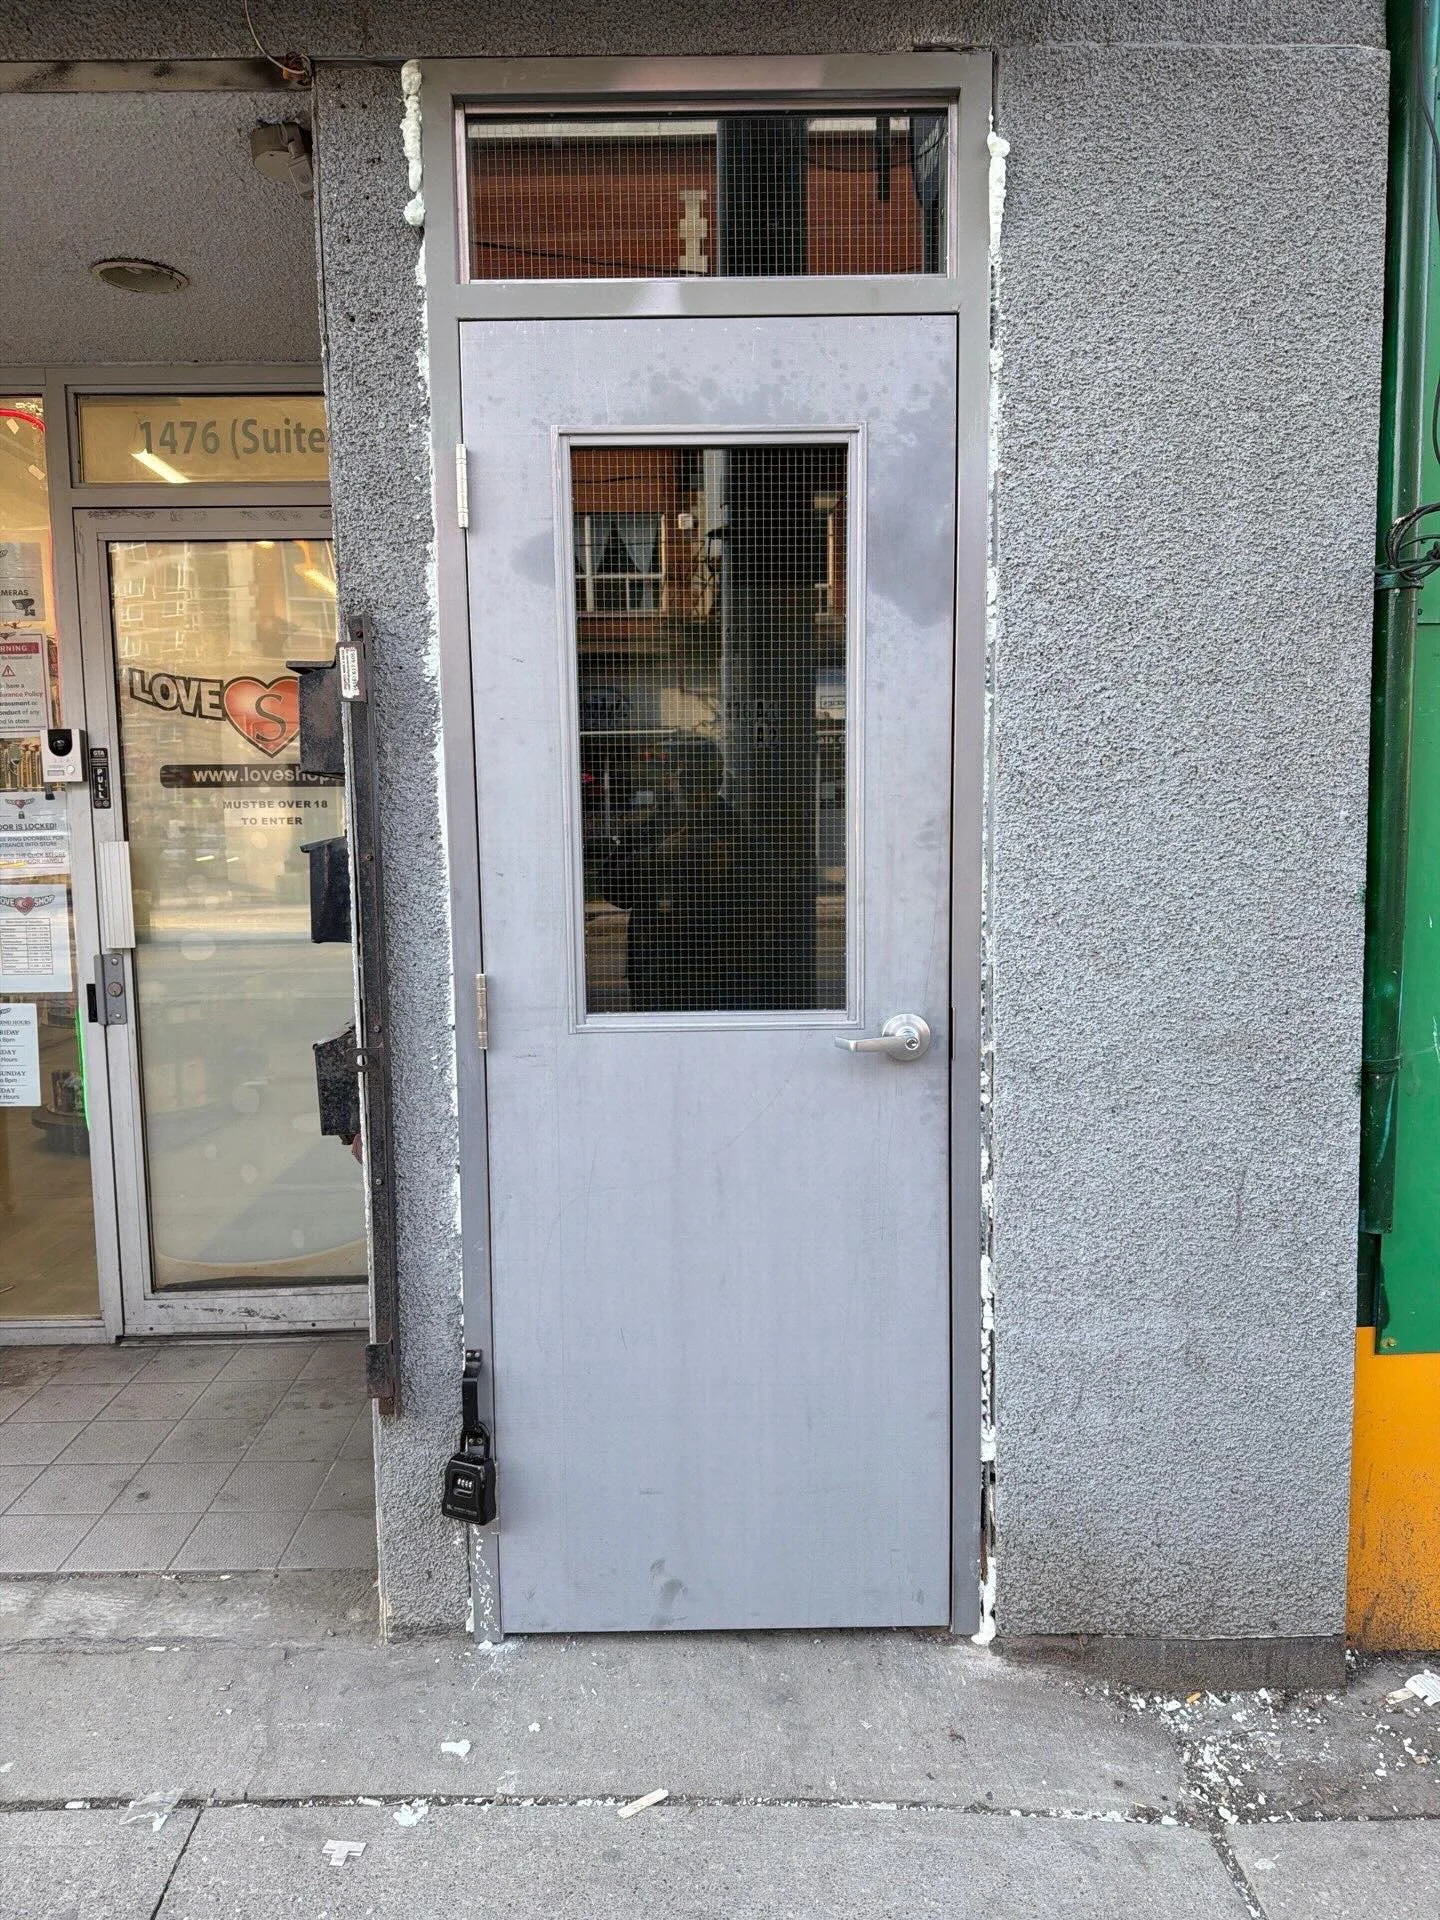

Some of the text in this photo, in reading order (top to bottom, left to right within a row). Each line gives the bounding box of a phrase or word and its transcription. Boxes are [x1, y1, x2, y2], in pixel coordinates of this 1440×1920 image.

[139, 418, 326, 460] 1476 (Suite
[129, 668, 287, 742] LOVE S
[96, 768, 105, 799] PULL
[278, 800, 312, 809] OVER
[314, 800, 328, 809] 18
[241, 816, 303, 826] TO ENTER
